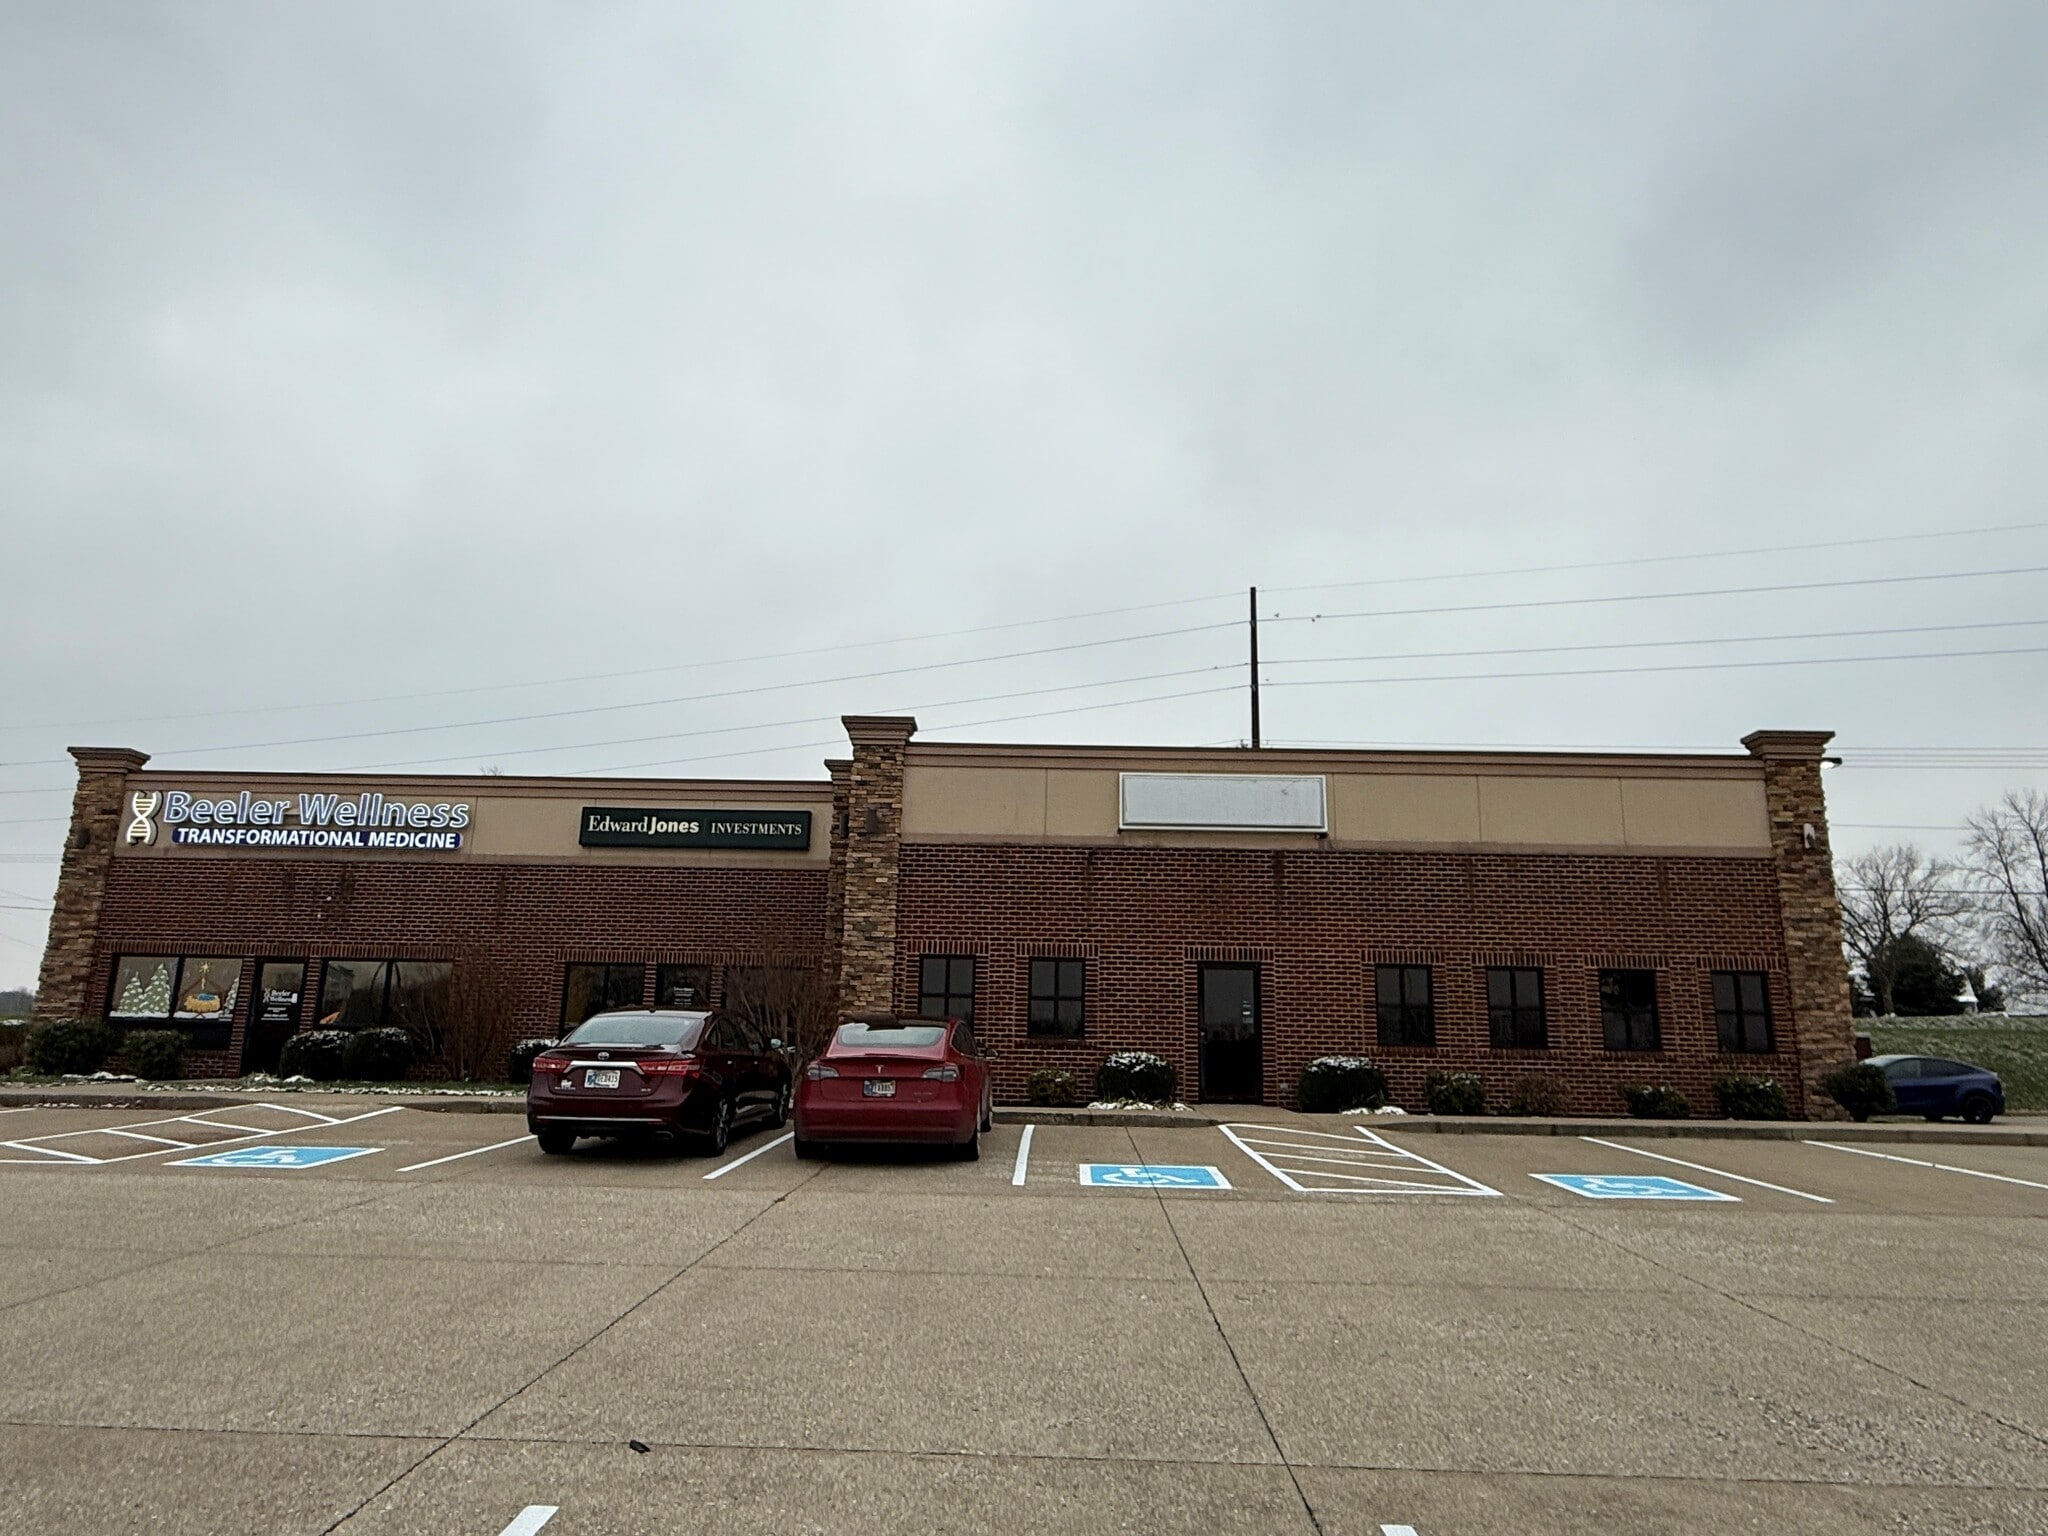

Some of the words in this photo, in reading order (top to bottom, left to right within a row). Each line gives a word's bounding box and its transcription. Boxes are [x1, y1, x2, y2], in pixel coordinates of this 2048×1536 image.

[163, 791, 291, 825] Beeler
[299, 793, 470, 828] Wellness
[177, 827, 365, 847] TRANSFORMATIONAL
[368, 832, 457, 849] MEDICINE
[711, 822, 803, 836] INVESTMENTS
